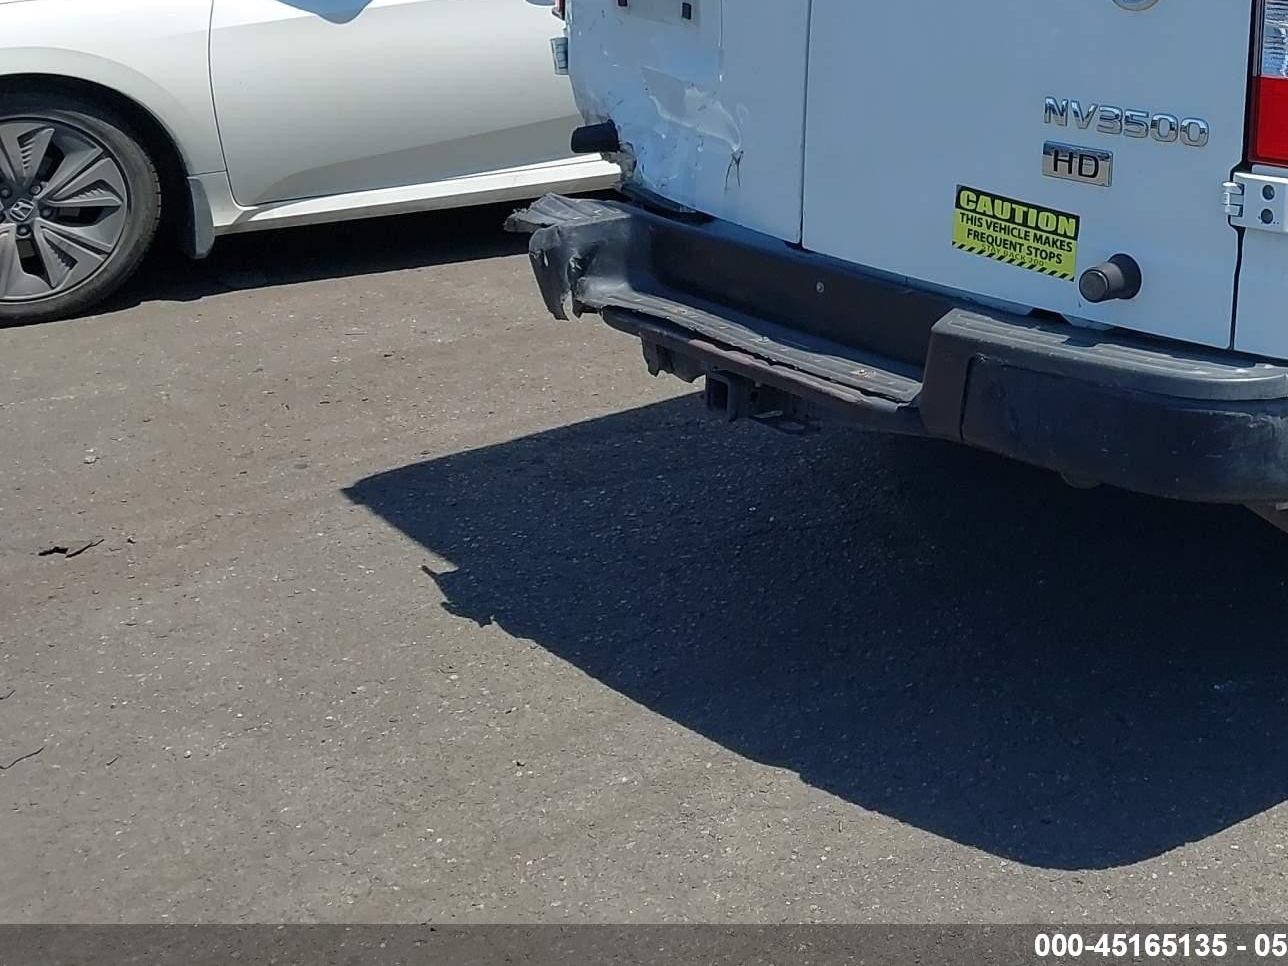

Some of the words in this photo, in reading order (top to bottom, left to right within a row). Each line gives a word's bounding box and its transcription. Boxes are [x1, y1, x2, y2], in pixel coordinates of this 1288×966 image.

[1044, 96, 1209, 147] NV3500
[1053, 149, 1100, 179] HD
[959, 190, 1077, 237] CAUTION
[960, 213, 983, 228] THIS
[985, 219, 1031, 242] VEHICLE
[1032, 233, 1073, 253] MAKES
[966, 228, 1025, 253] FREQUENT
[1026, 245, 1063, 265] STOPS
